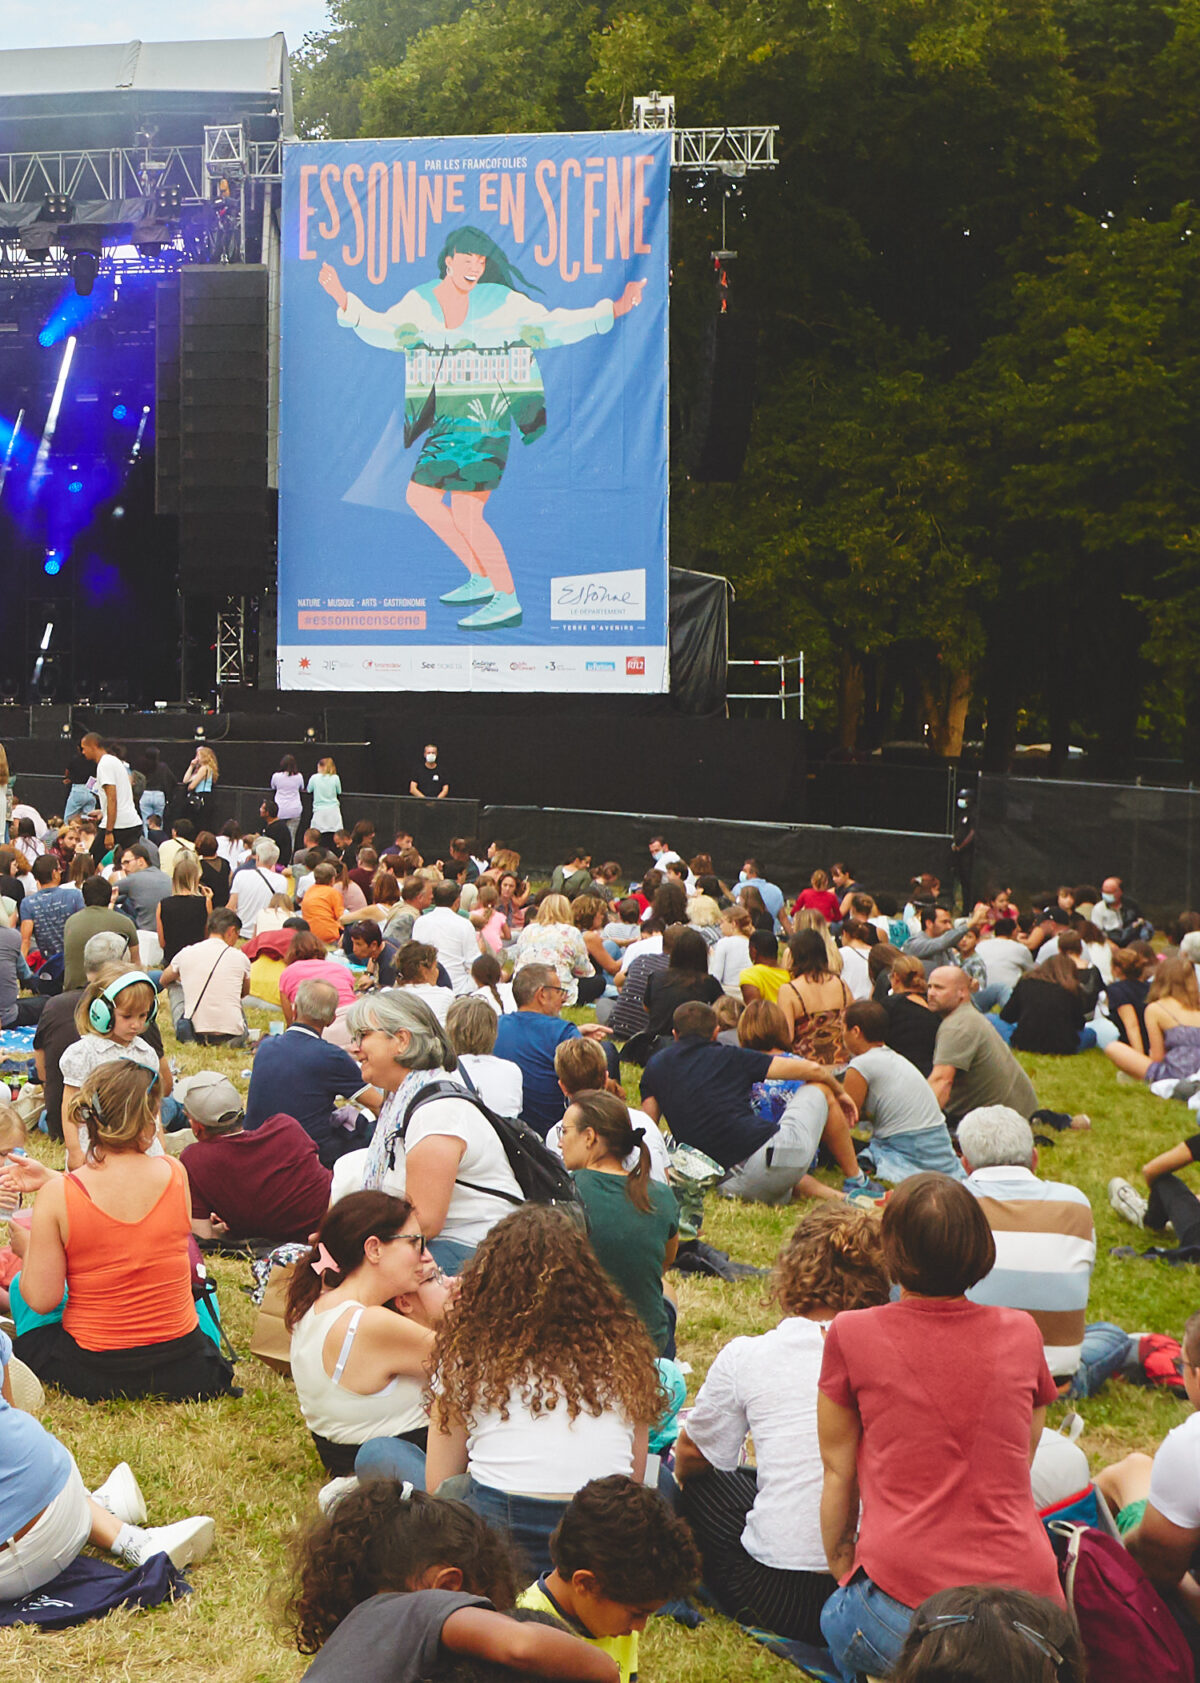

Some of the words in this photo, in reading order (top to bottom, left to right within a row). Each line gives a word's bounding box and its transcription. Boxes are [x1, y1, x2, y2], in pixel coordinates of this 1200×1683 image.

[425, 159, 442, 171] PAR
[444, 159, 461, 171] LES
[462, 157, 528, 170] FRANCOFOLIES
[299, 161, 465, 285] ESSONNE
[479, 173, 526, 243] EN
[298, 598, 321, 607] NATURE
[327, 598, 354, 607] MUSIQUE
[362, 598, 377, 607] ARTS
[383, 598, 427, 607] GASTRONOMIE
